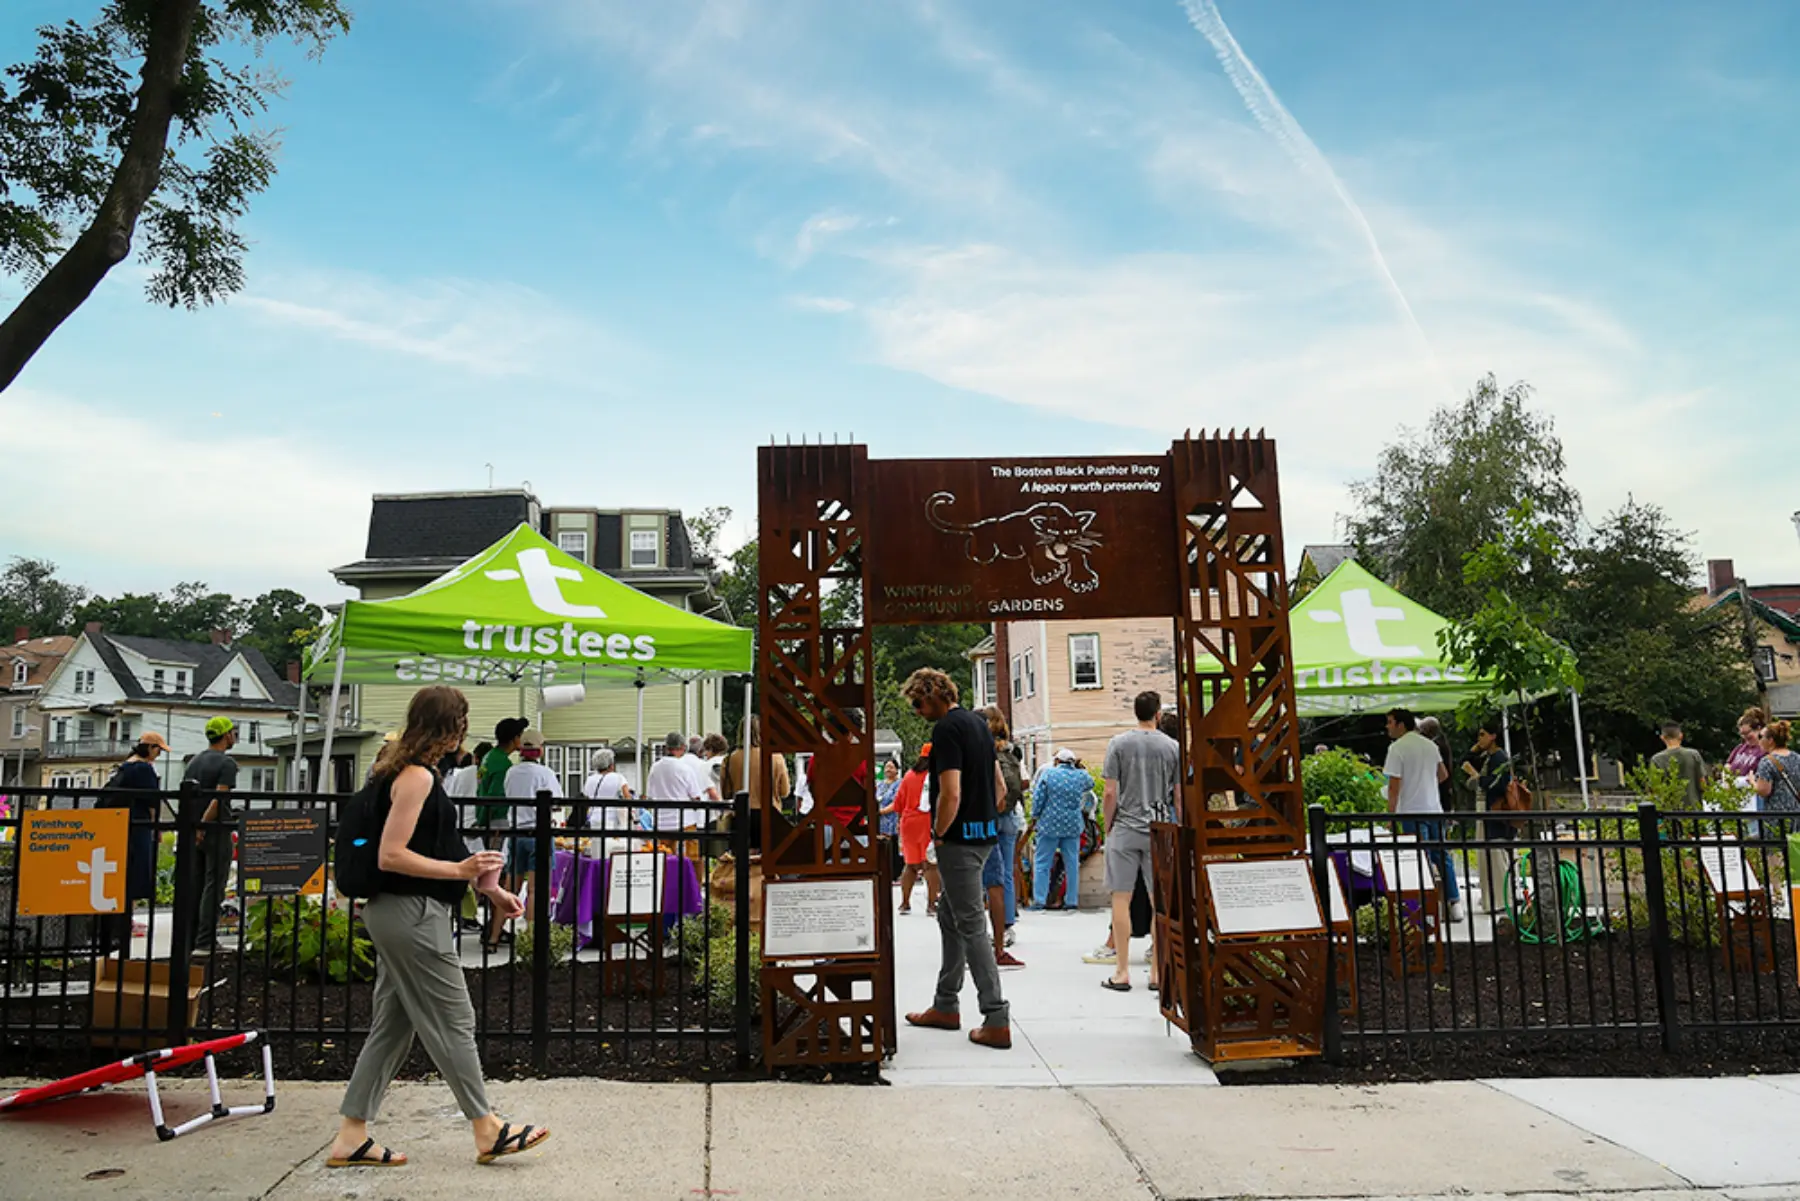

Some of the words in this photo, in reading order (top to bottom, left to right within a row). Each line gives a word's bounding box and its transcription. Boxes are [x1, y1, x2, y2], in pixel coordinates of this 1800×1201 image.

[991, 466, 1012, 477] The
[1014, 466, 1053, 477] Boston
[1055, 465, 1084, 476] Black
[1087, 465, 1128, 476] Panther
[1131, 464, 1160, 477] Party
[1020, 482, 1030, 492] A
[1032, 481, 1068, 494] legacy
[1070, 481, 1101, 492] worth
[1103, 480, 1161, 493] preserving
[987, 597, 1065, 613] GARDENS
[462, 619, 656, 661] trustees
[1296, 659, 1467, 689] rustees
[31, 818, 84, 831] Winthrop
[29, 830, 96, 842] Community
[29, 842, 71, 853] Garden
